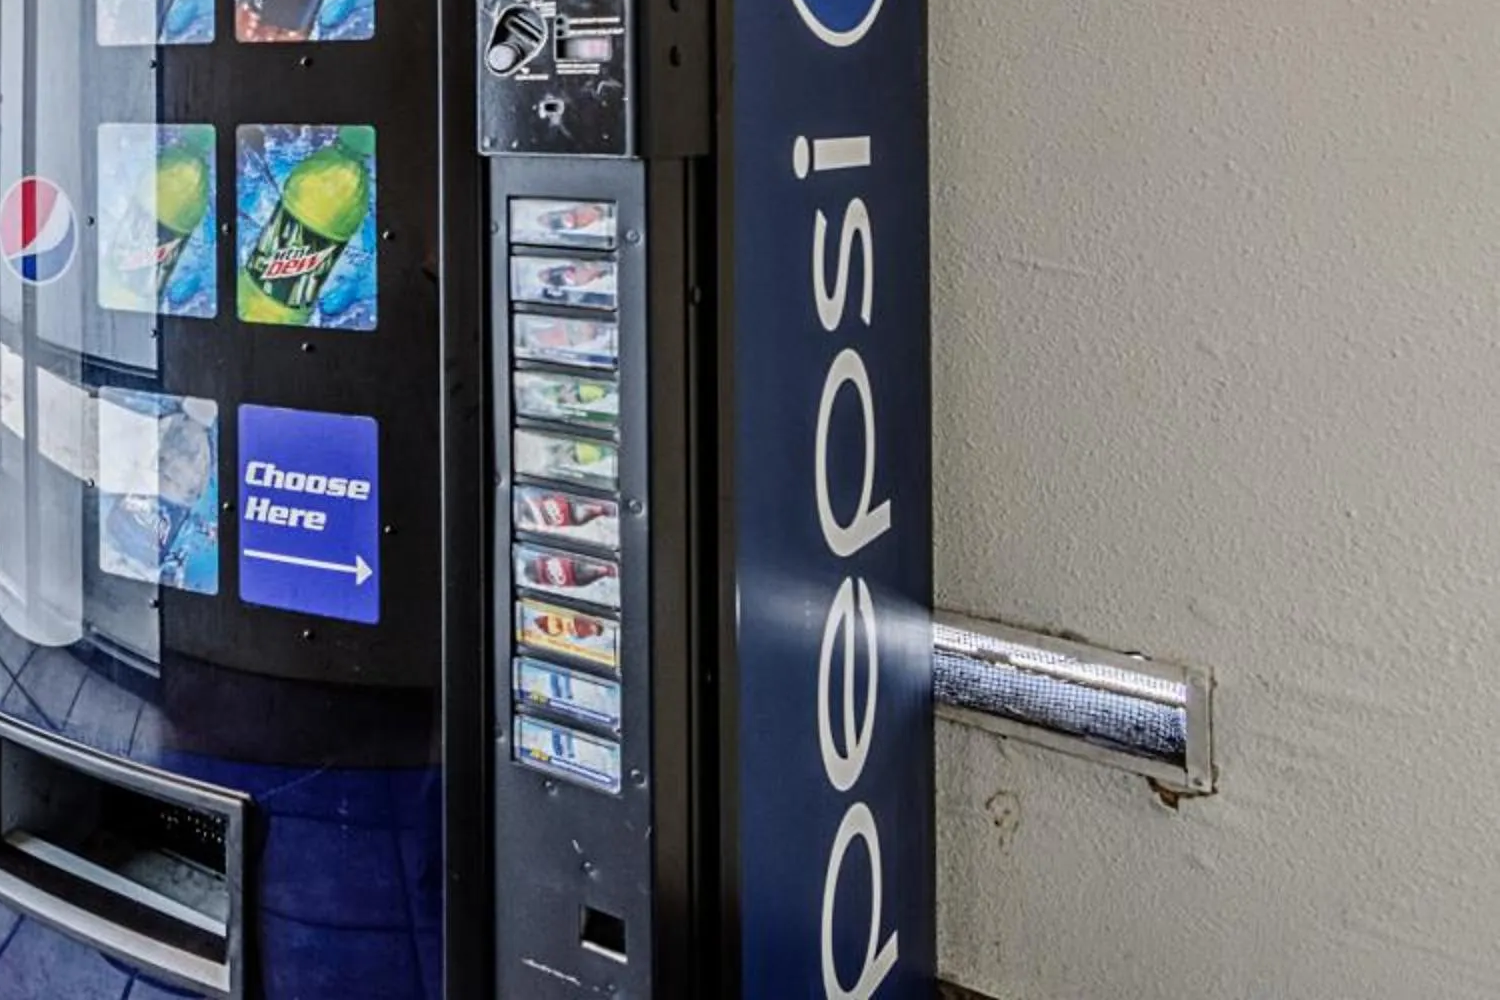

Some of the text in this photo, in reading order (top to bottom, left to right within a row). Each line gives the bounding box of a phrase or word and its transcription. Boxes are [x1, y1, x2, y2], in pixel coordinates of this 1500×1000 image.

[244, 460, 371, 501] Choose
[244, 495, 328, 531] Here
[792, 134, 899, 1000] pepsi
